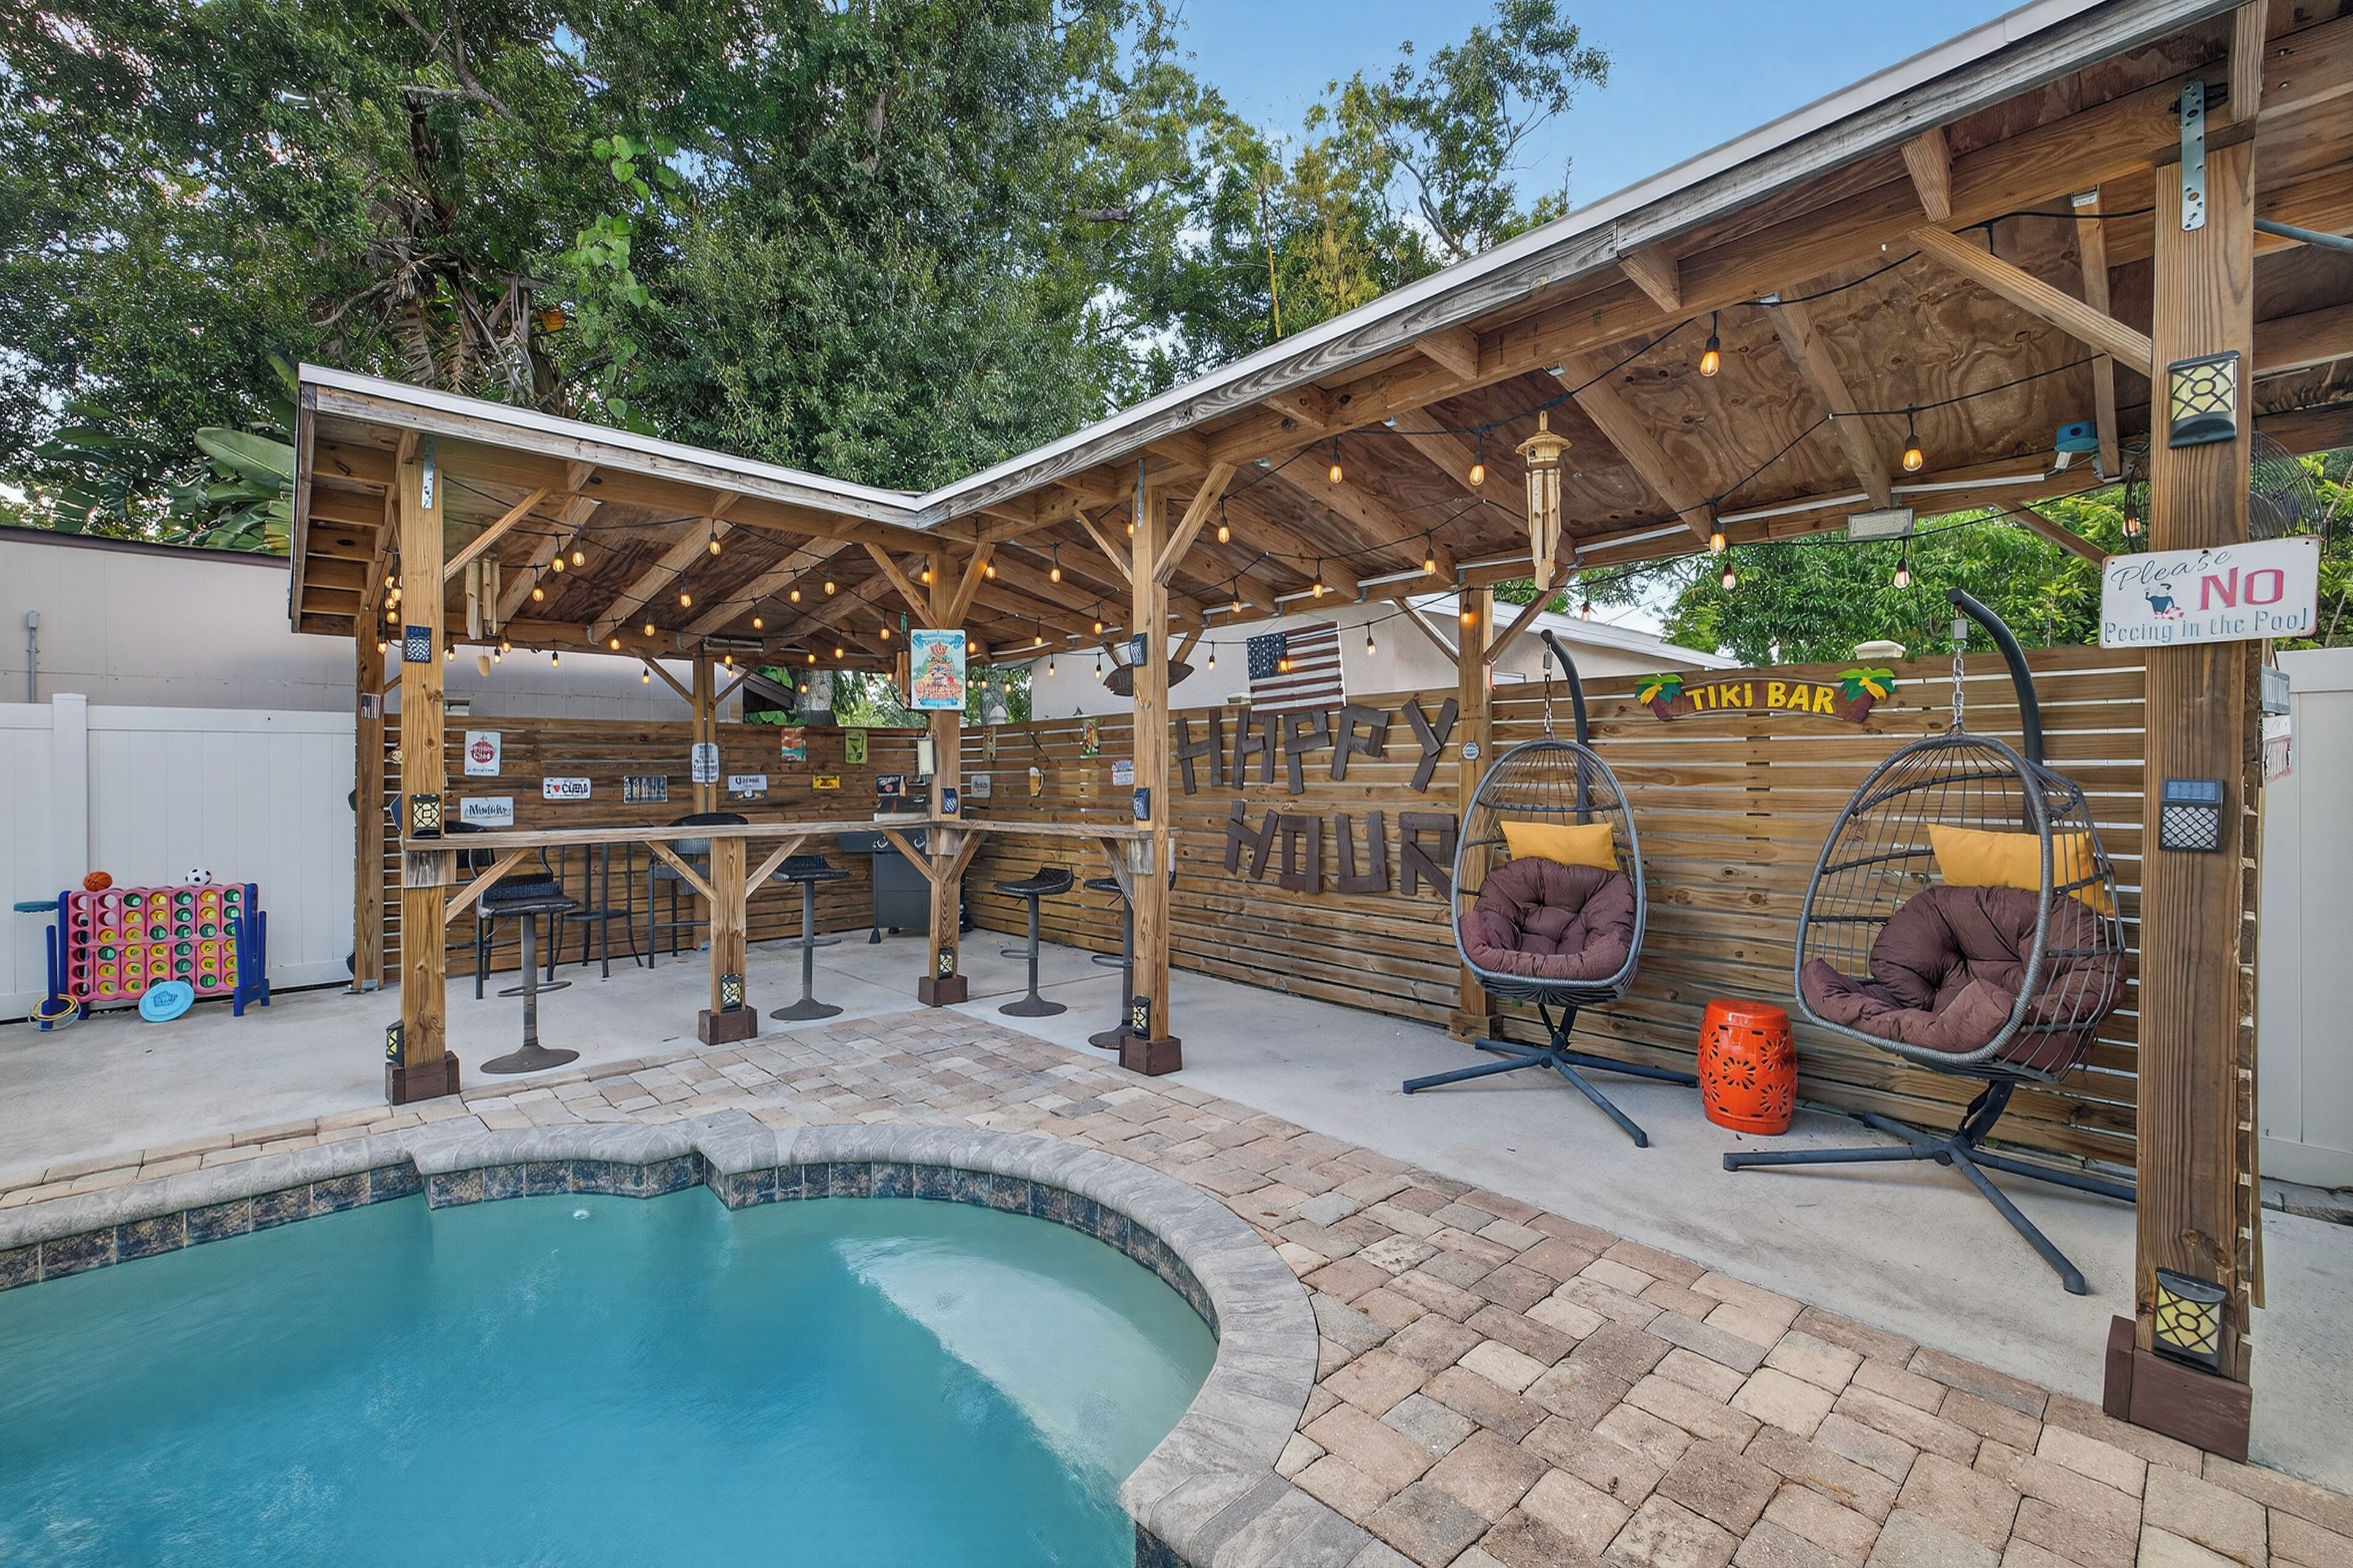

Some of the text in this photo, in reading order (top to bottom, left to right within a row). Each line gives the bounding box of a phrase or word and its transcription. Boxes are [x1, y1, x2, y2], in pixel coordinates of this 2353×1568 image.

[2111, 551, 2232, 591] Please
[2198, 566, 2284, 611] NO
[2104, 607, 2307, 643] Peeing in the Pool
[1685, 681, 1834, 714] TIKI BAR
[1172, 697, 1458, 795] HAPPY
[1224, 801, 1457, 901] HOUR
